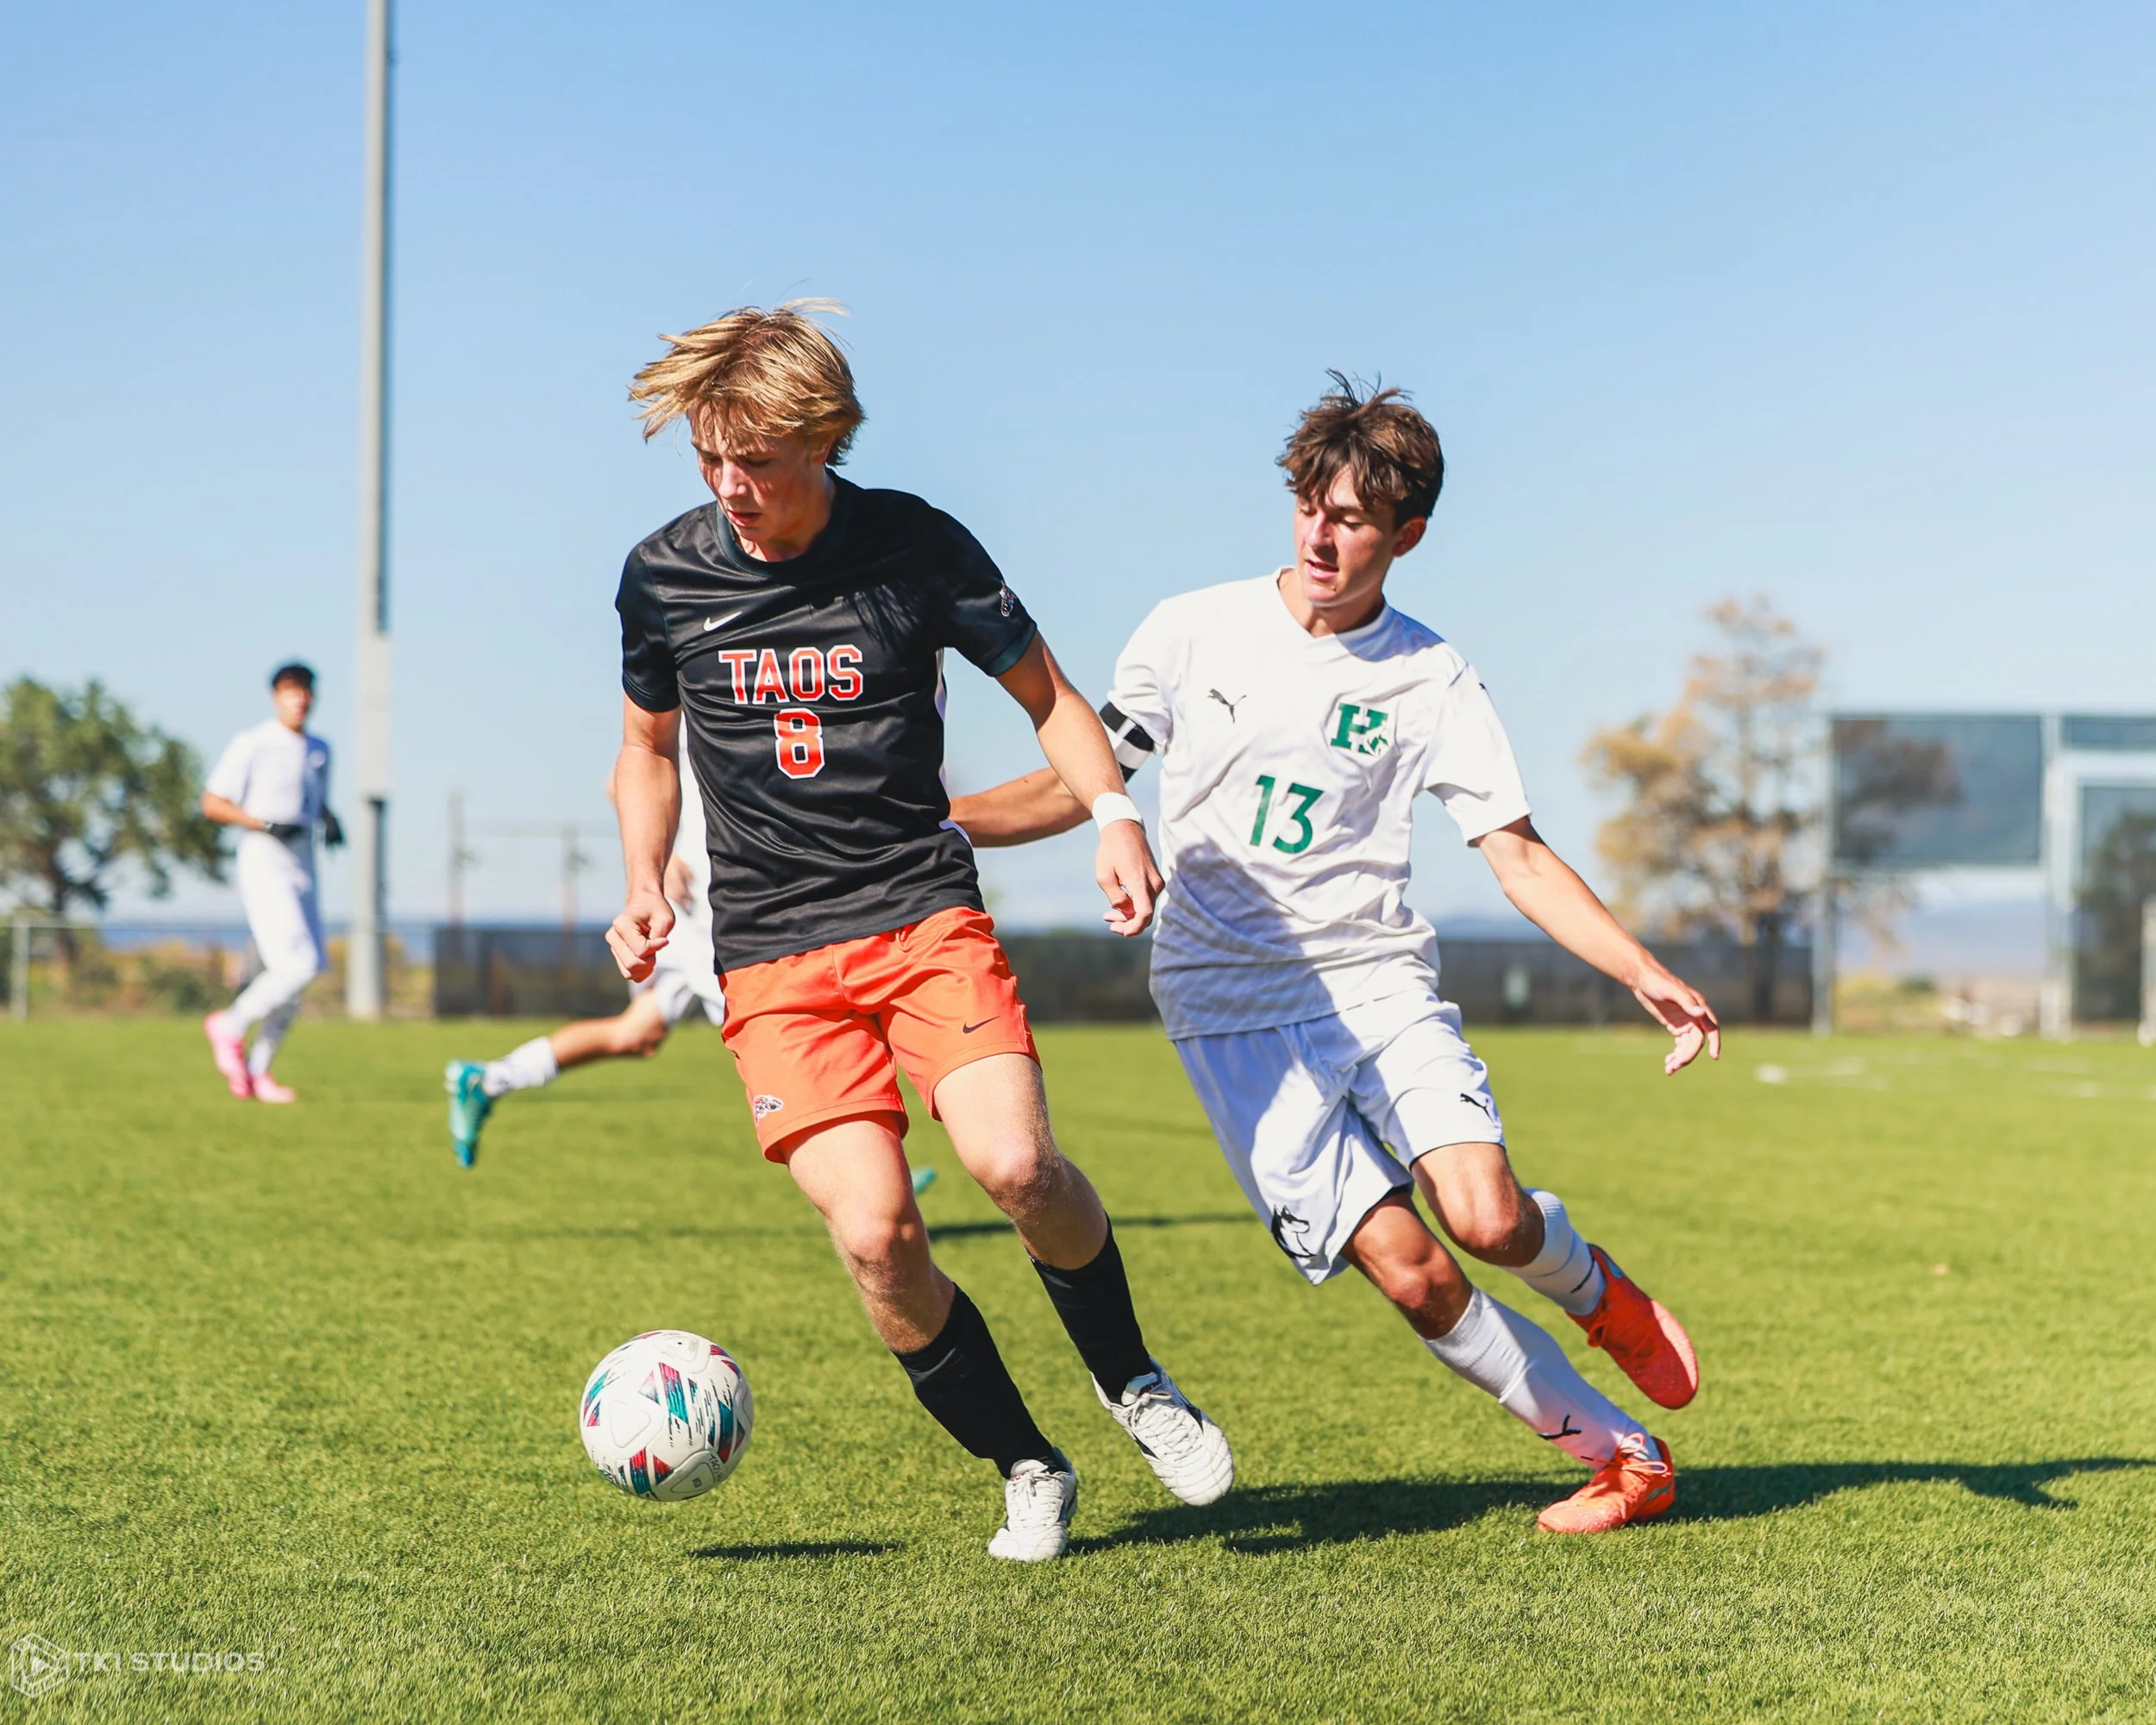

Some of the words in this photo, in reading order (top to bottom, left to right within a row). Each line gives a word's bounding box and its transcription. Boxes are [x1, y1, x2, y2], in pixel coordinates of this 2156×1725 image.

[718, 644, 863, 705] TAOS
[774, 707, 825, 780] 8
[1250, 775, 1325, 854] 13
